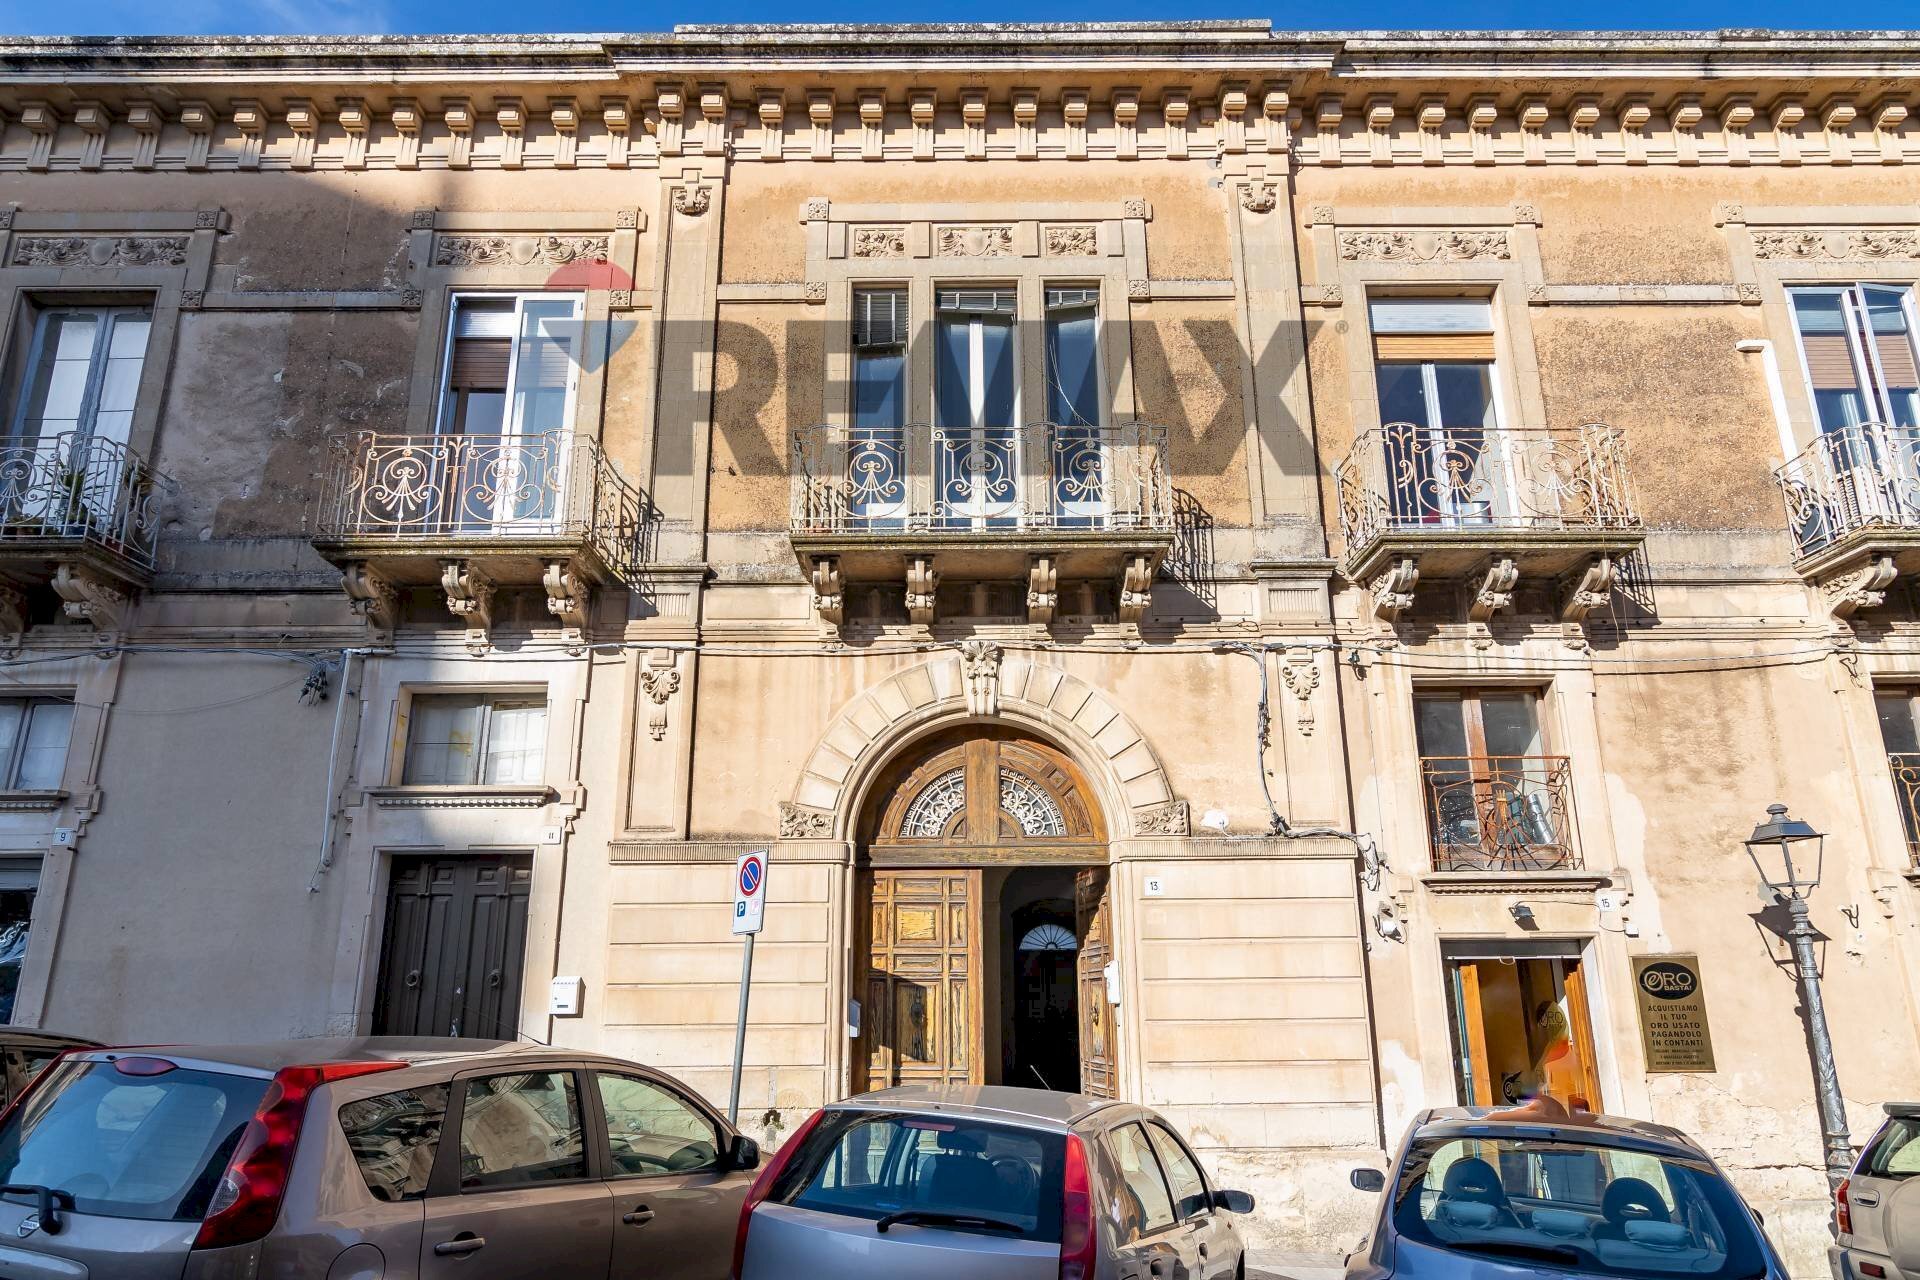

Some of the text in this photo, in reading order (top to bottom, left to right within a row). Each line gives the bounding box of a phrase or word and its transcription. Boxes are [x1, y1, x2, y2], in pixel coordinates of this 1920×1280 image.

[60, 832, 67, 842] 9
[1150, 881, 1158, 891] 13
[1601, 898, 1610, 908] 15
[1648, 1004, 1698, 1012] ACQUISTIAMO
[1664, 1039, 1703, 1047] CONTANTI
